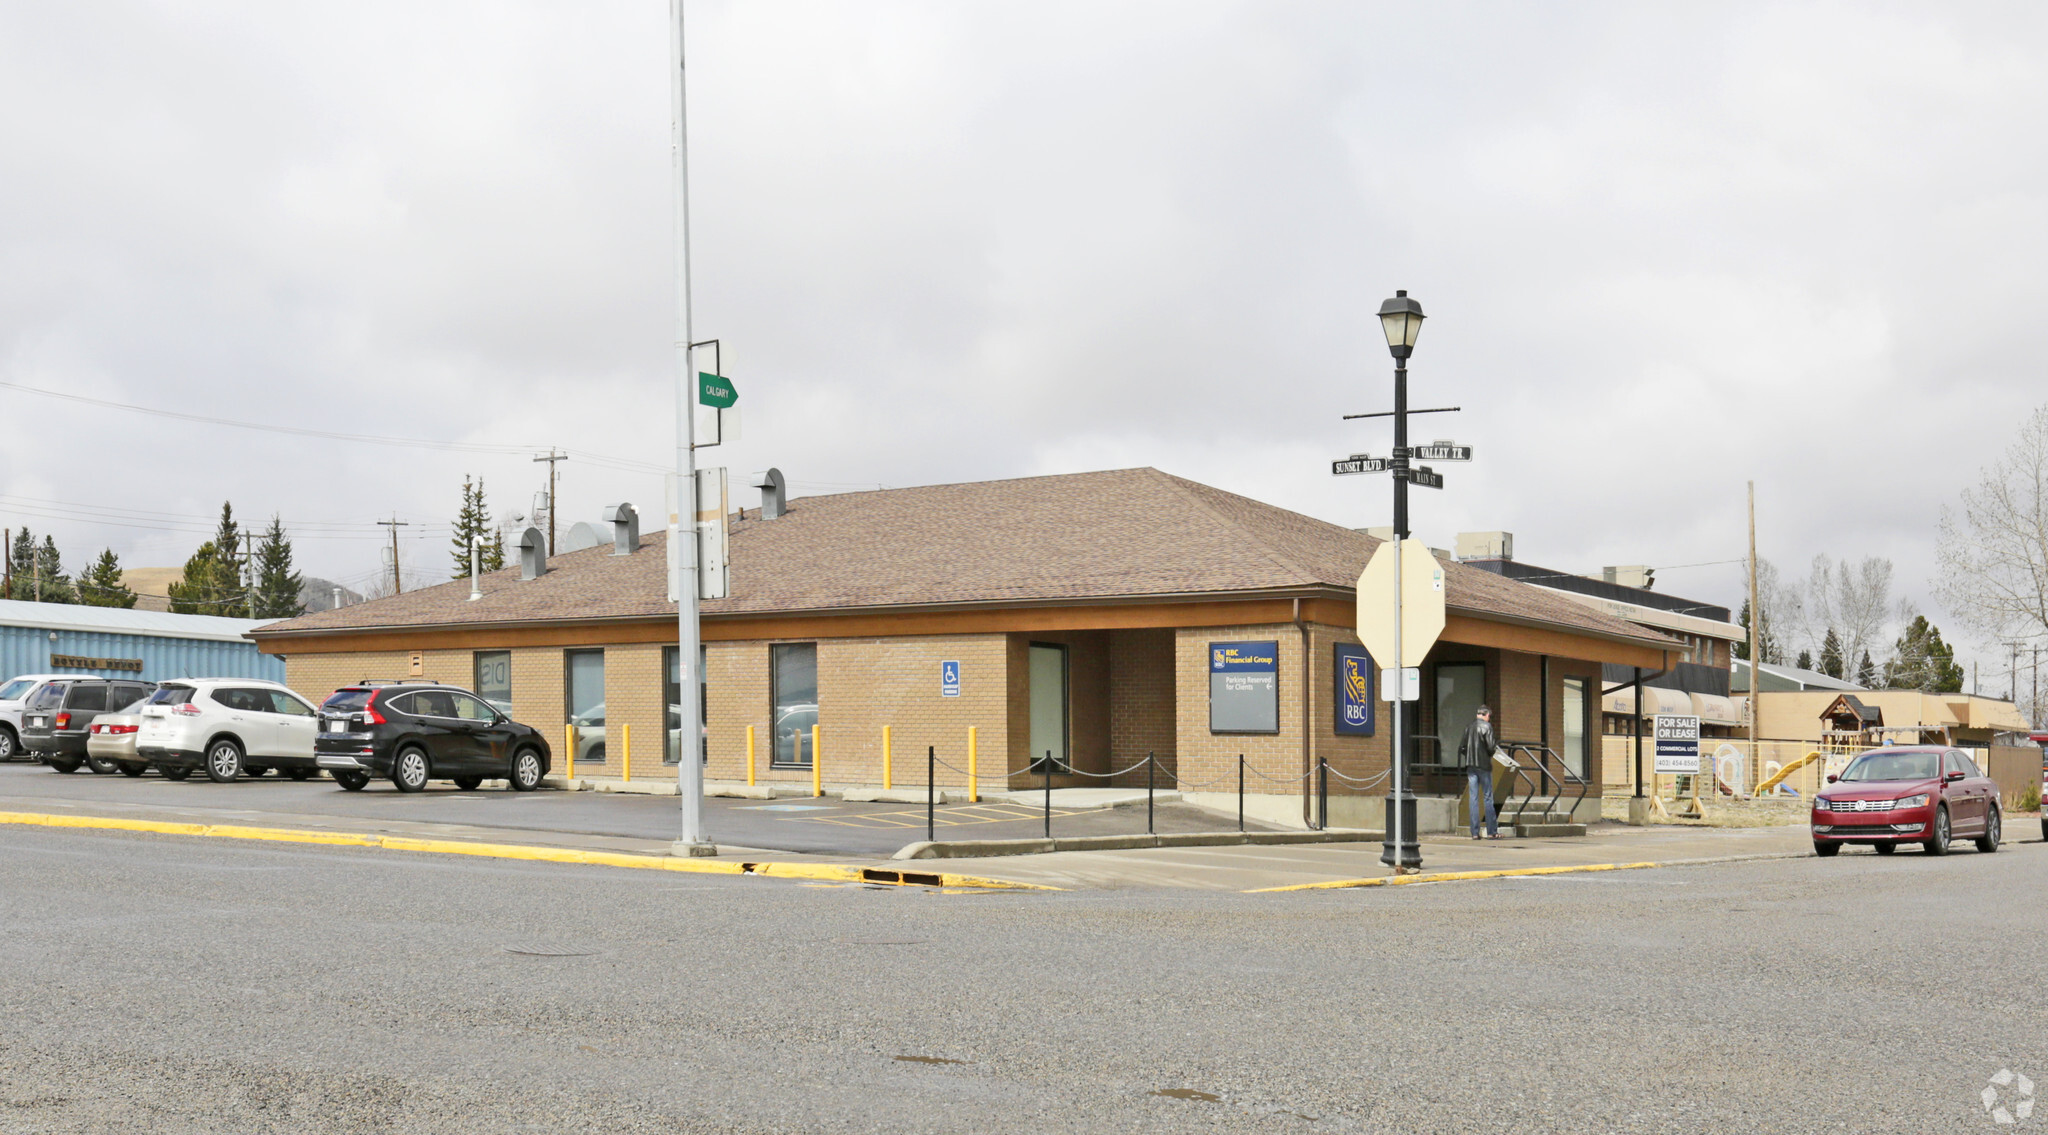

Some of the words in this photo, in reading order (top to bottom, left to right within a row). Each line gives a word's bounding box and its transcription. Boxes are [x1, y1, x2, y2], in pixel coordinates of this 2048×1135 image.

[705, 384, 729, 399] CALGARY
[1420, 447, 1449, 459] VALLEY
[1452, 447, 1466, 460] TR.
[1335, 461, 1361, 473] SUNSET
[1363, 459, 1383, 472] BLVD.
[1416, 472, 1429, 484] MAIN
[1430, 474, 1437, 485] ST
[1225, 655, 1253, 663] Financial
[1253, 656, 1273, 665] Group
[1225, 676, 1247, 685] Parking
[1247, 676, 1272, 684] Reserved
[1346, 704, 1365, 720] RBC
[1658, 718, 1675, 728] FOR
[1676, 718, 1696, 728] SALE
[1658, 728, 1671, 738] OR
[1672, 729, 1696, 738] LEASE
[1656, 759, 1671, 767] (403)
